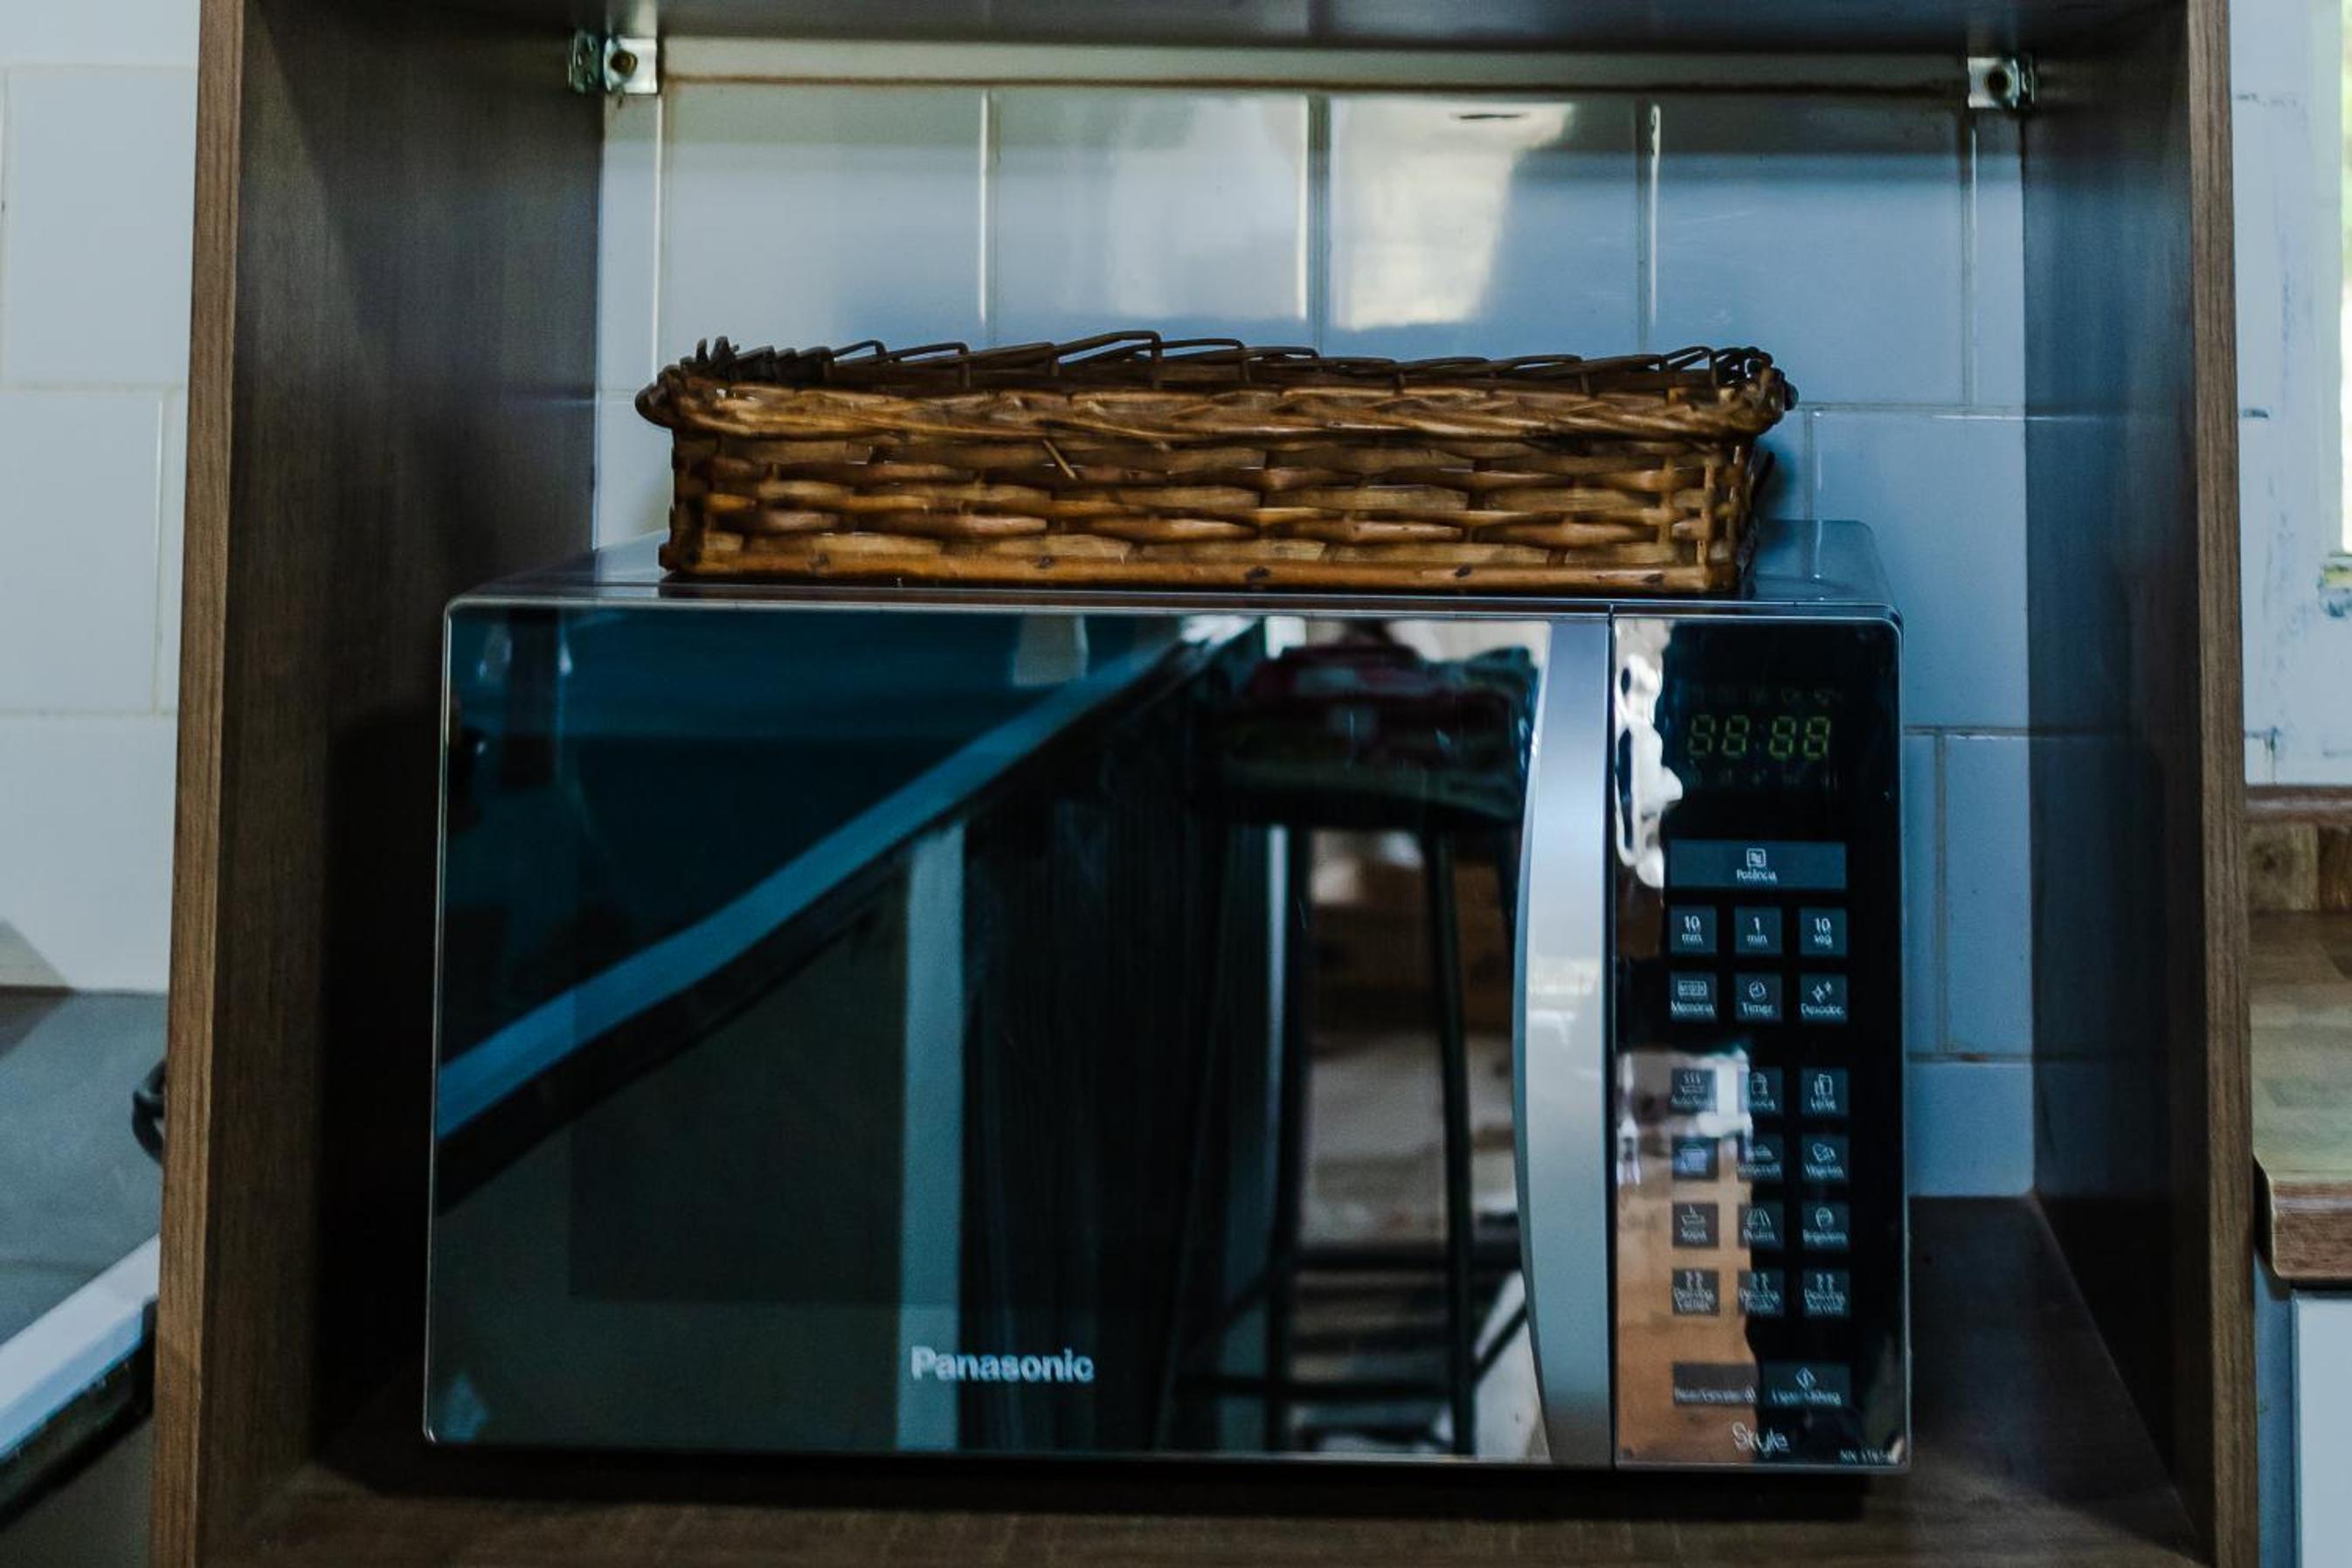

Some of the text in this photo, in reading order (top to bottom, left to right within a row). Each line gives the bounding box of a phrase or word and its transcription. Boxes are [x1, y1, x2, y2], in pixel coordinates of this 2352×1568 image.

[1684, 915, 1701, 931] 10
[1754, 917, 1761, 931] 1
[1815, 918, 1831, 932] 10
[1742, 1002, 1774, 1016] Timer
[911, 1345, 1094, 1383] Panasonic
[1733, 1421, 1790, 1458] Style
